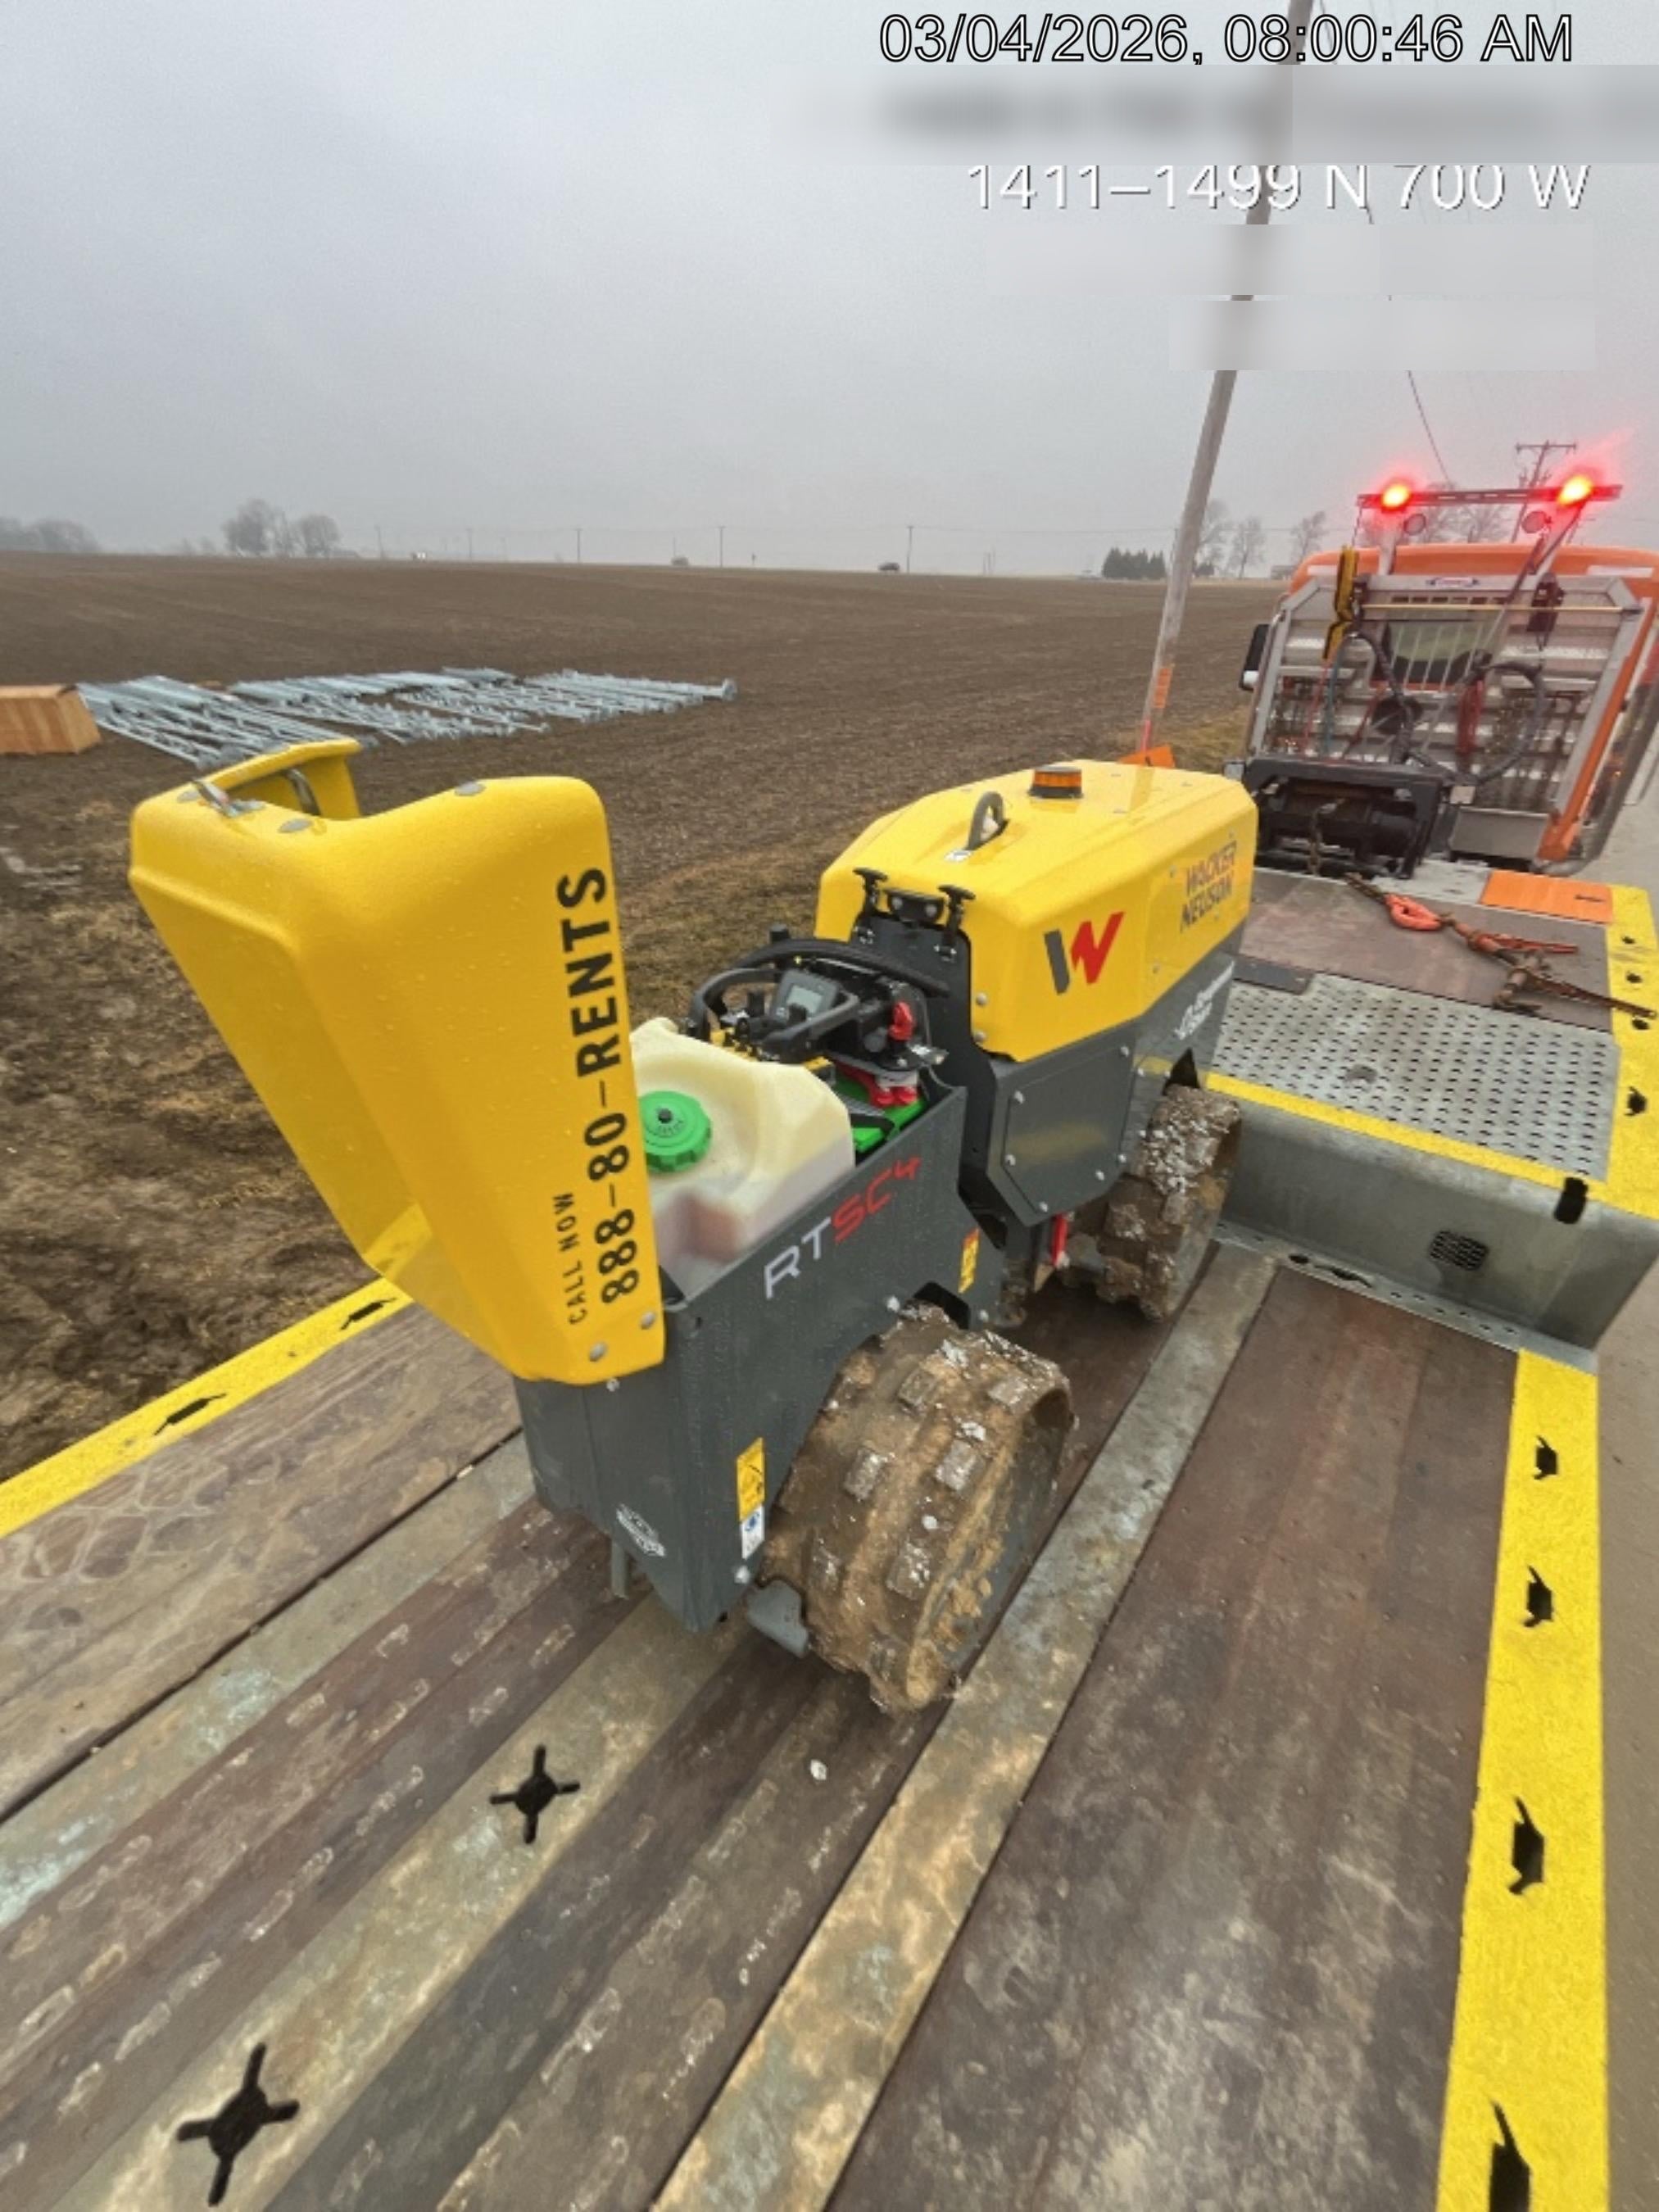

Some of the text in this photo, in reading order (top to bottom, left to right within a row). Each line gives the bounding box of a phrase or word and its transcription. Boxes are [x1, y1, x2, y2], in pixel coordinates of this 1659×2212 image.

[556, 866, 640, 1304] 888-80-RENTS
[552, 1192, 588, 1326] CALL NOW
